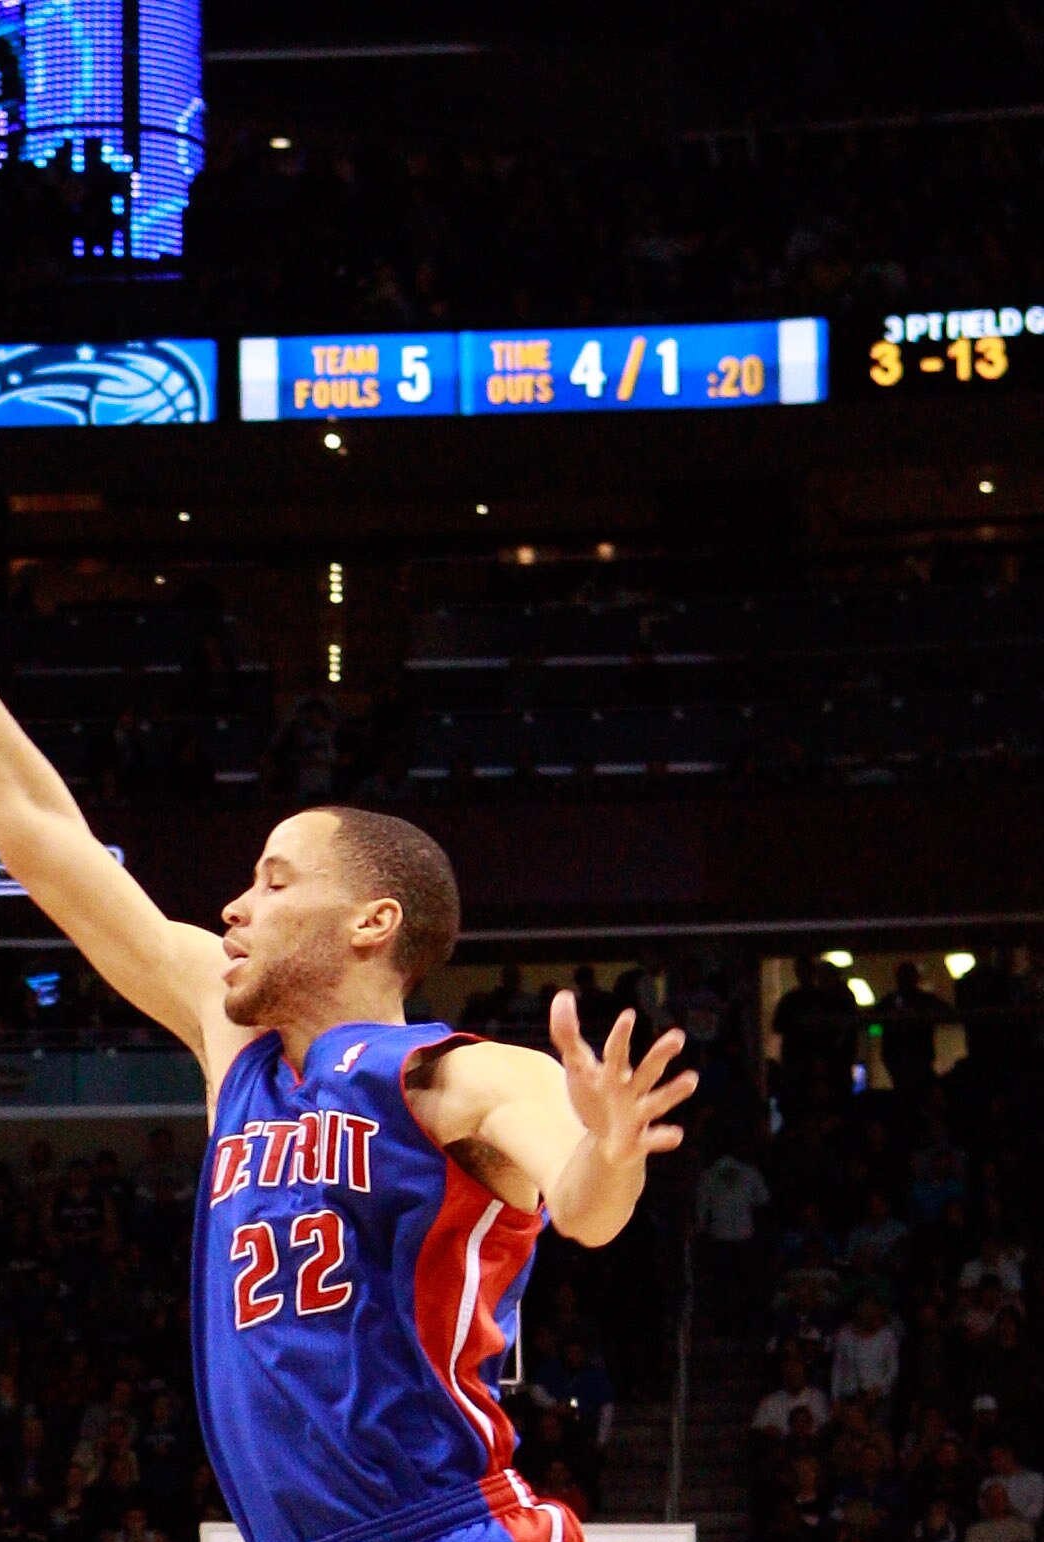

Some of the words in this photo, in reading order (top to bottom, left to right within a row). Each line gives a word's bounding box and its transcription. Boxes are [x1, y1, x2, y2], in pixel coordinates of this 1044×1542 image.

[883, 314, 905, 344] 3
[907, 311, 944, 343] PT
[946, 307, 1024, 339] FIELD
[311, 344, 379, 375] TEAM
[489, 339, 551, 371] TIME
[397, 345, 432, 402] 5
[486, 373, 554, 405] OUTS
[294, 378, 380, 409] FOULS
[209, 1110, 380, 1209] DETRIT
[230, 1209, 353, 1331] 22
